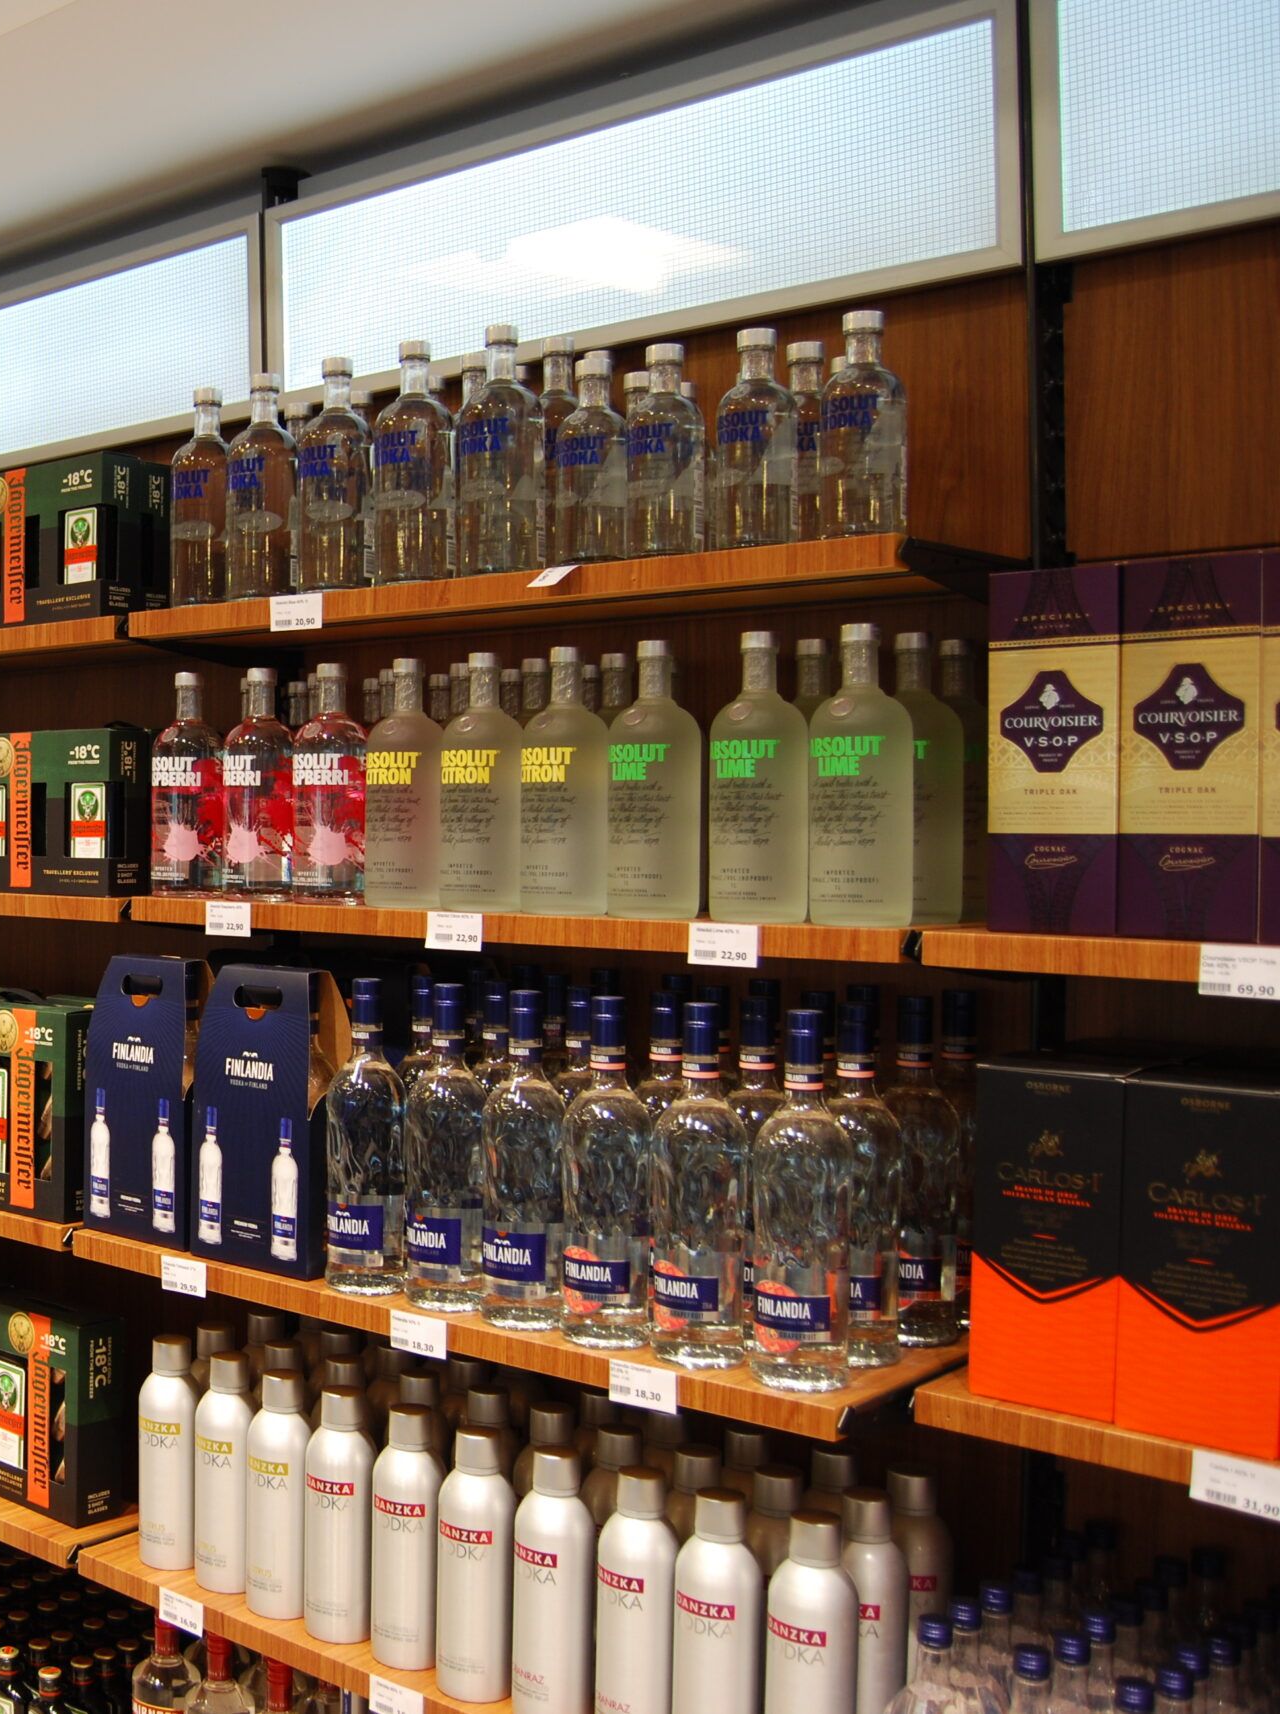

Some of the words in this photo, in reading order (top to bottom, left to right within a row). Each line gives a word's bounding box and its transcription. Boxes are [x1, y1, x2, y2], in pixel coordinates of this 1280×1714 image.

[63, 469, 93, 486] -18°C
[296, 617, 315, 627] 20,90
[1005, 715, 1098, 732] COURVOISIER
[1138, 710, 1239, 727] COURVOISIER
[70, 744, 100, 760] -18°C
[612, 762, 647, 780] LIME
[716, 759, 756, 779] LIME
[818, 756, 860, 776] LIME
[226, 922, 244, 931] 22,90
[456, 934, 478, 943] 22,90
[721, 951, 747, 961] 22,90
[1237, 984, 1276, 998] 69,90
[24, 1027, 53, 1041] -18°C
[112, 1042, 154, 1064] FINLANDIA
[225, 1058, 274, 1081] FINLANDIA
[483, 1242, 531, 1266] FINLANDIA
[565, 1261, 612, 1283] FINLANDIA
[757, 1296, 811, 1320] FINLANDIA
[40, 1334, 66, 1351] -18°C
[412, 1341, 434, 1353] 18,30
[94, 1338, 107, 1388] -18°C
[635, 1389, 661, 1402] 18,30
[375, 1496, 422, 1517] DANZKA
[1243, 1498, 1280, 1517] 31,90
[440, 1521, 489, 1544] DANZKA
[677, 1592, 731, 1618] DANZKA
[680, 1616, 733, 1639] ODKA
[768, 1617, 822, 1645] DANZKA
